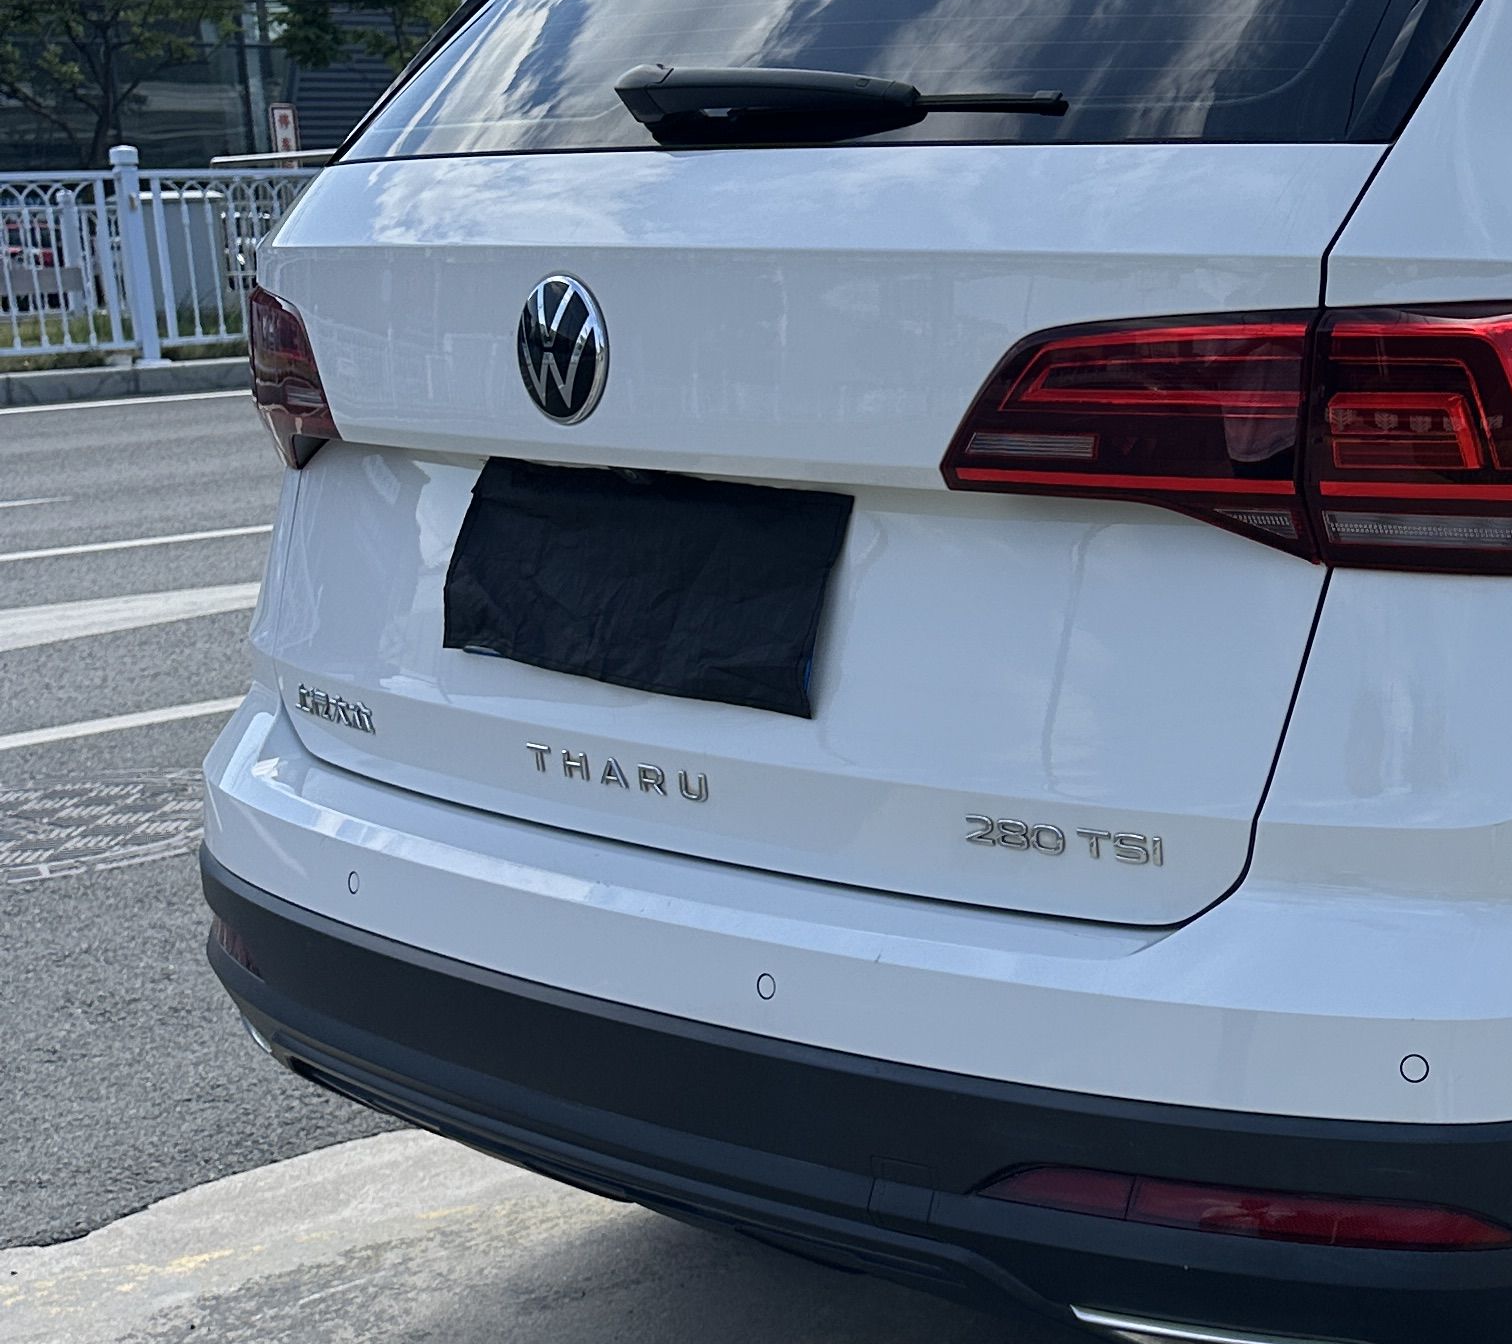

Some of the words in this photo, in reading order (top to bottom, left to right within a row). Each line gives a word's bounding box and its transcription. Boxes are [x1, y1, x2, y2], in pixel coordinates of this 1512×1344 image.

[295, 682, 376, 735] 上汽大众
[525, 741, 710, 803] THARU
[964, 813, 1066, 856] 280
[1076, 826, 1164, 867] TSI
